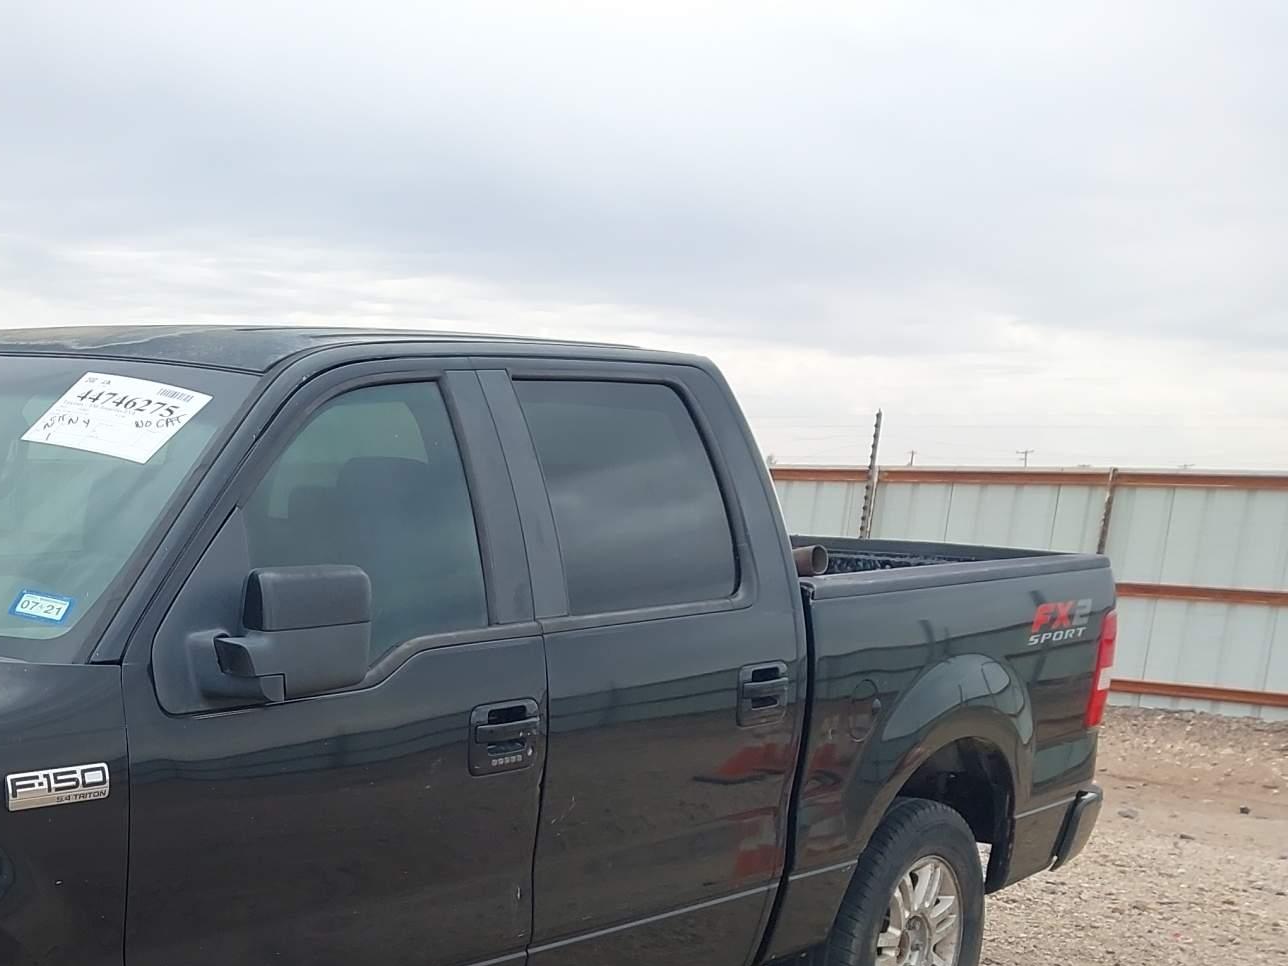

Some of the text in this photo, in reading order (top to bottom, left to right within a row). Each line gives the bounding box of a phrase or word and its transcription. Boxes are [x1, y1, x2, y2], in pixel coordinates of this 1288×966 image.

[76, 389, 181, 418] 44746275
[134, 419, 152, 429] NO
[1032, 598, 1092, 634] FX2
[1027, 626, 1087, 646] SPORT
[10, 766, 107, 798] F-150
[73, 789, 107, 801] TRITON
